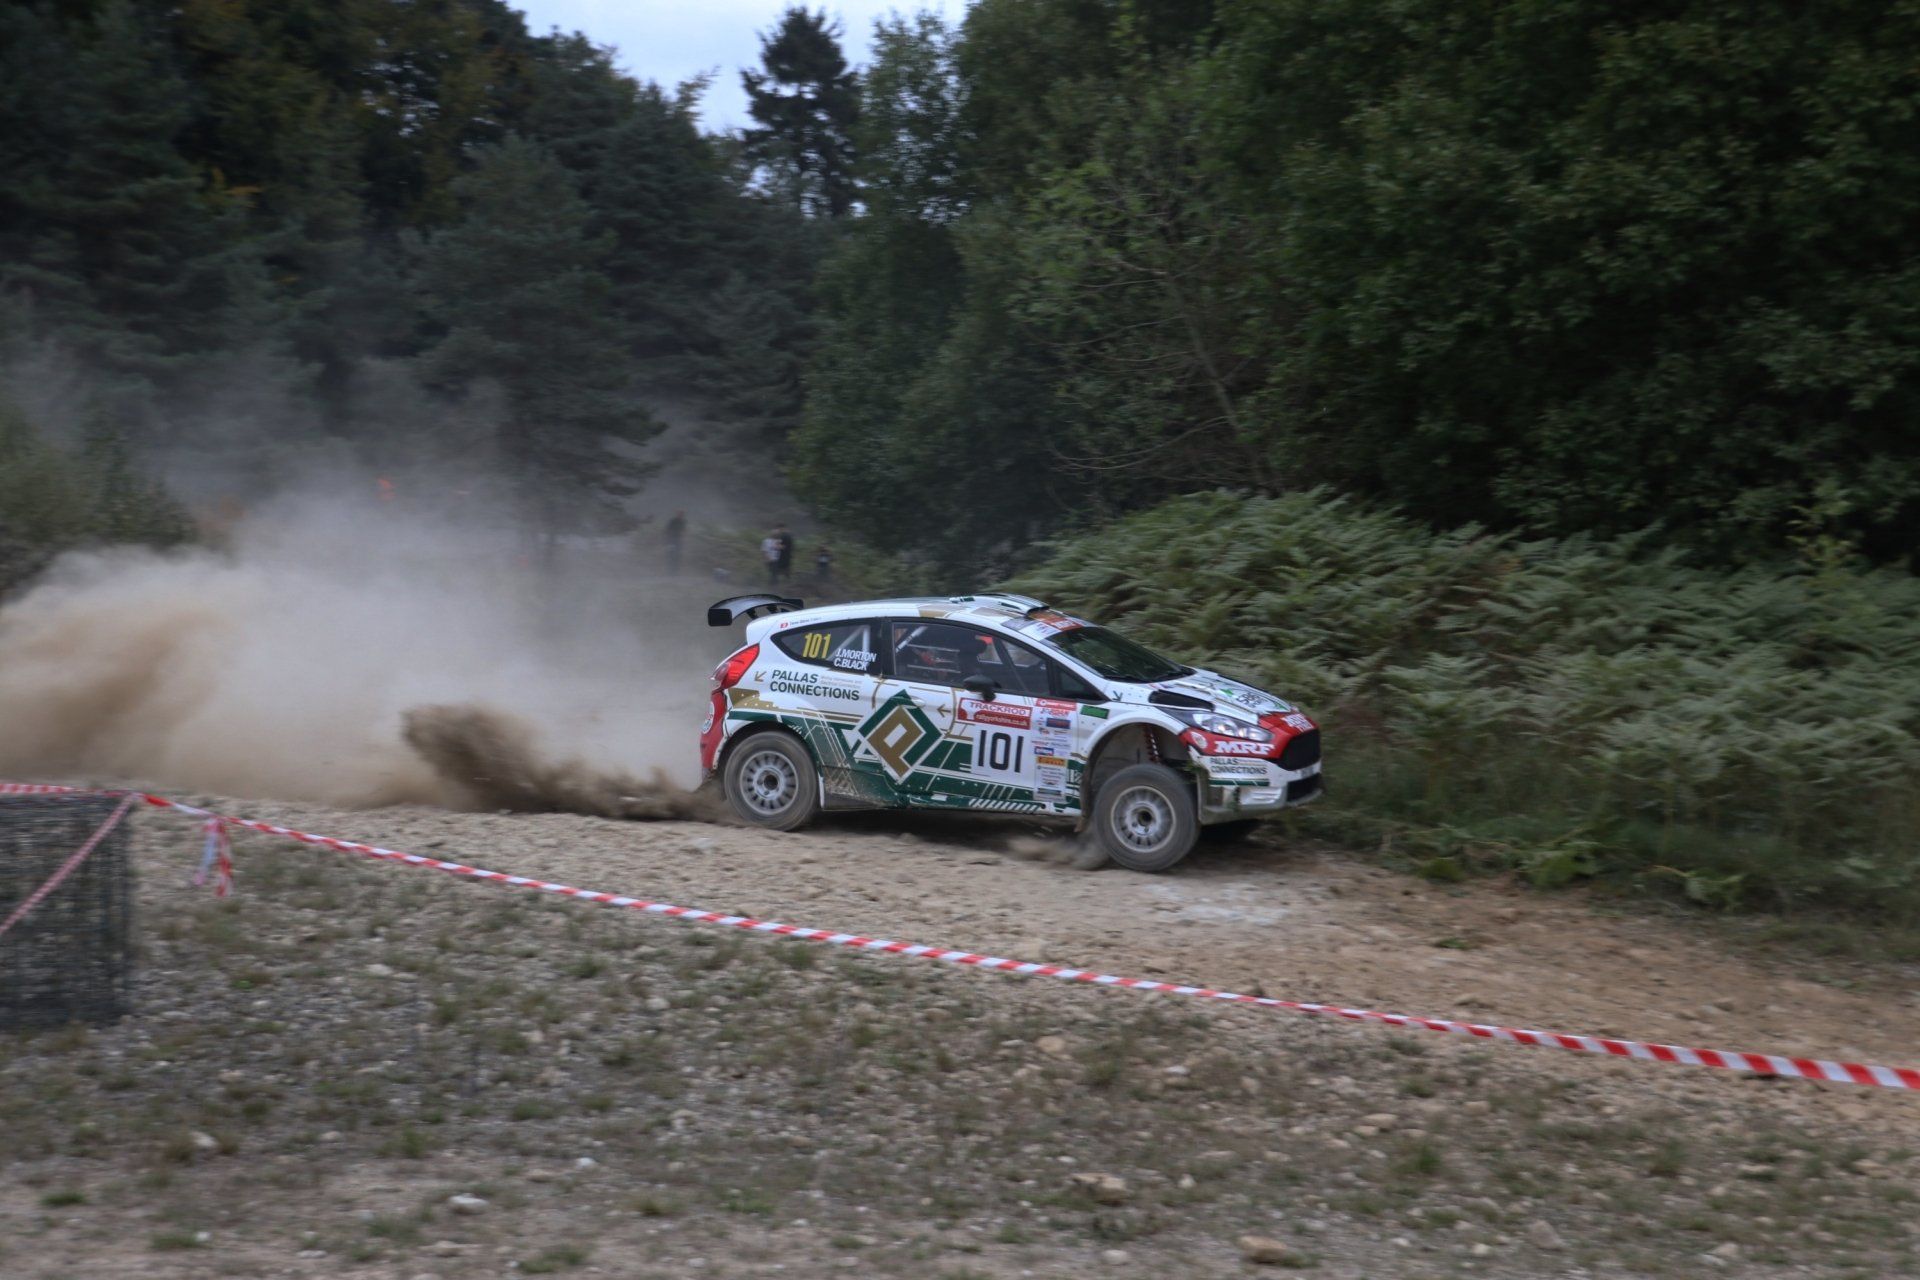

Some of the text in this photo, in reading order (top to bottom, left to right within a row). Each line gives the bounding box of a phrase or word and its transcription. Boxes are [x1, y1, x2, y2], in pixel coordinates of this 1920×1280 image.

[803, 633, 831, 659] 101
[835, 649, 877, 662] J.MORTON
[834, 659, 869, 671] C.BLACK
[771, 669, 818, 683] PALLAS
[770, 681, 860, 700] CONNECTIONS
[970, 702, 1026, 715] TRACKROD
[978, 730, 1024, 773] 101
[1214, 740, 1275, 756] MRF
[1210, 757, 1239, 765] PALLAS
[1210, 765, 1268, 775] CONNECTIONS
